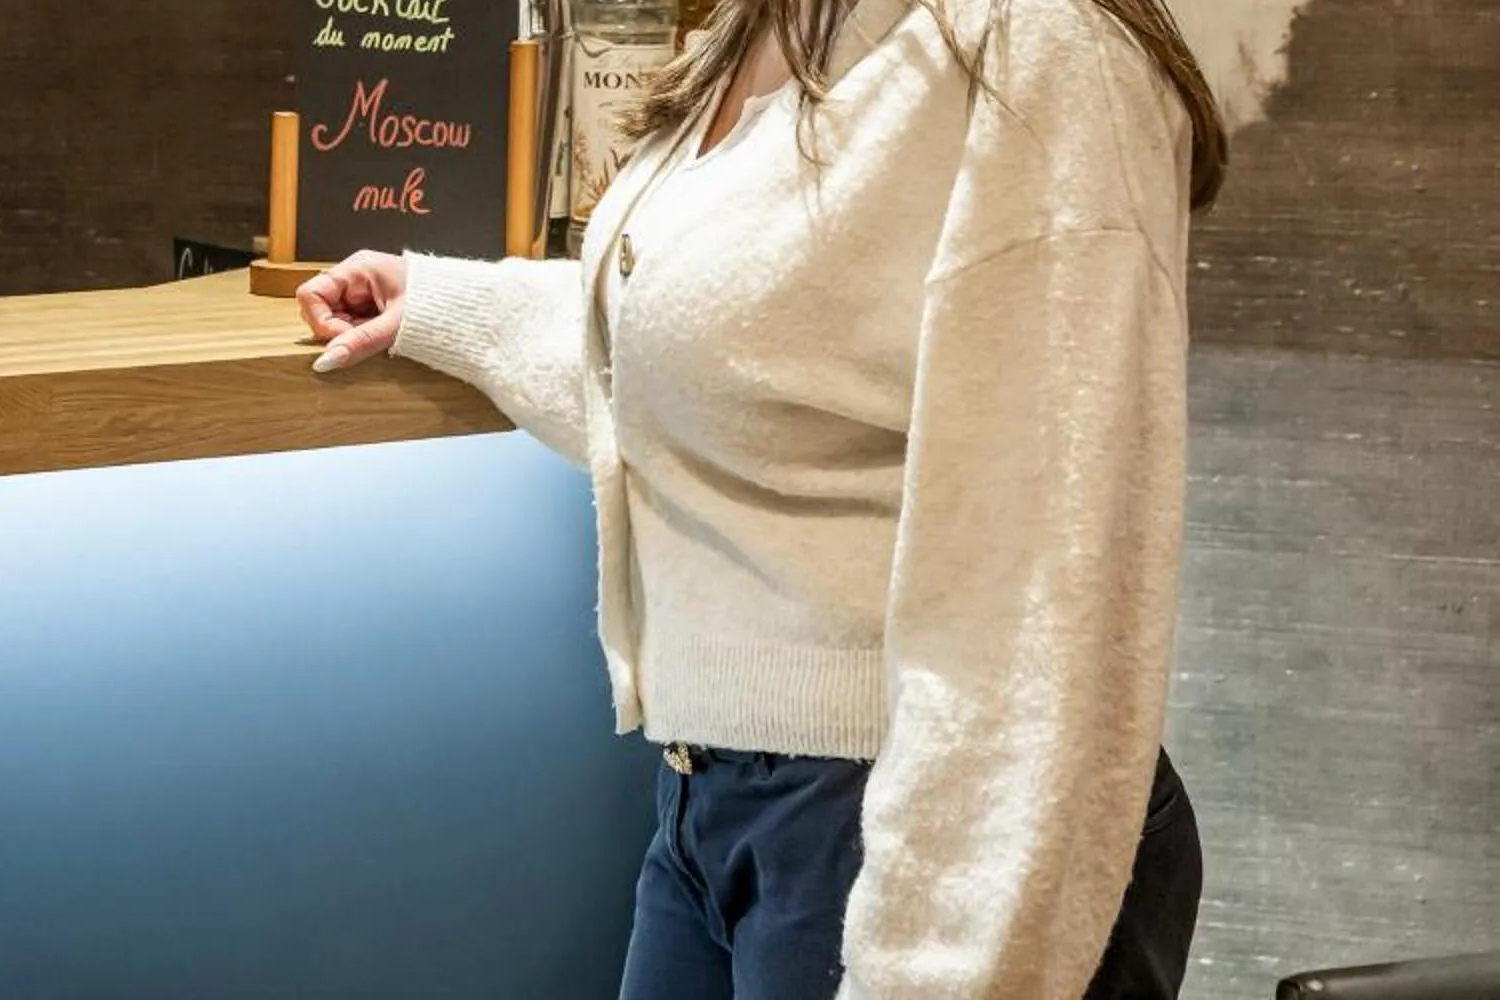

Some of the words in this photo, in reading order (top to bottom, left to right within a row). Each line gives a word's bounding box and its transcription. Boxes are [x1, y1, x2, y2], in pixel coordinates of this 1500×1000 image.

[312, 16, 346, 47] du
[360, 26, 455, 52] moment
[583, 71, 643, 90] MON
[310, 78, 472, 150] Moscow
[353, 167, 432, 214] mule
